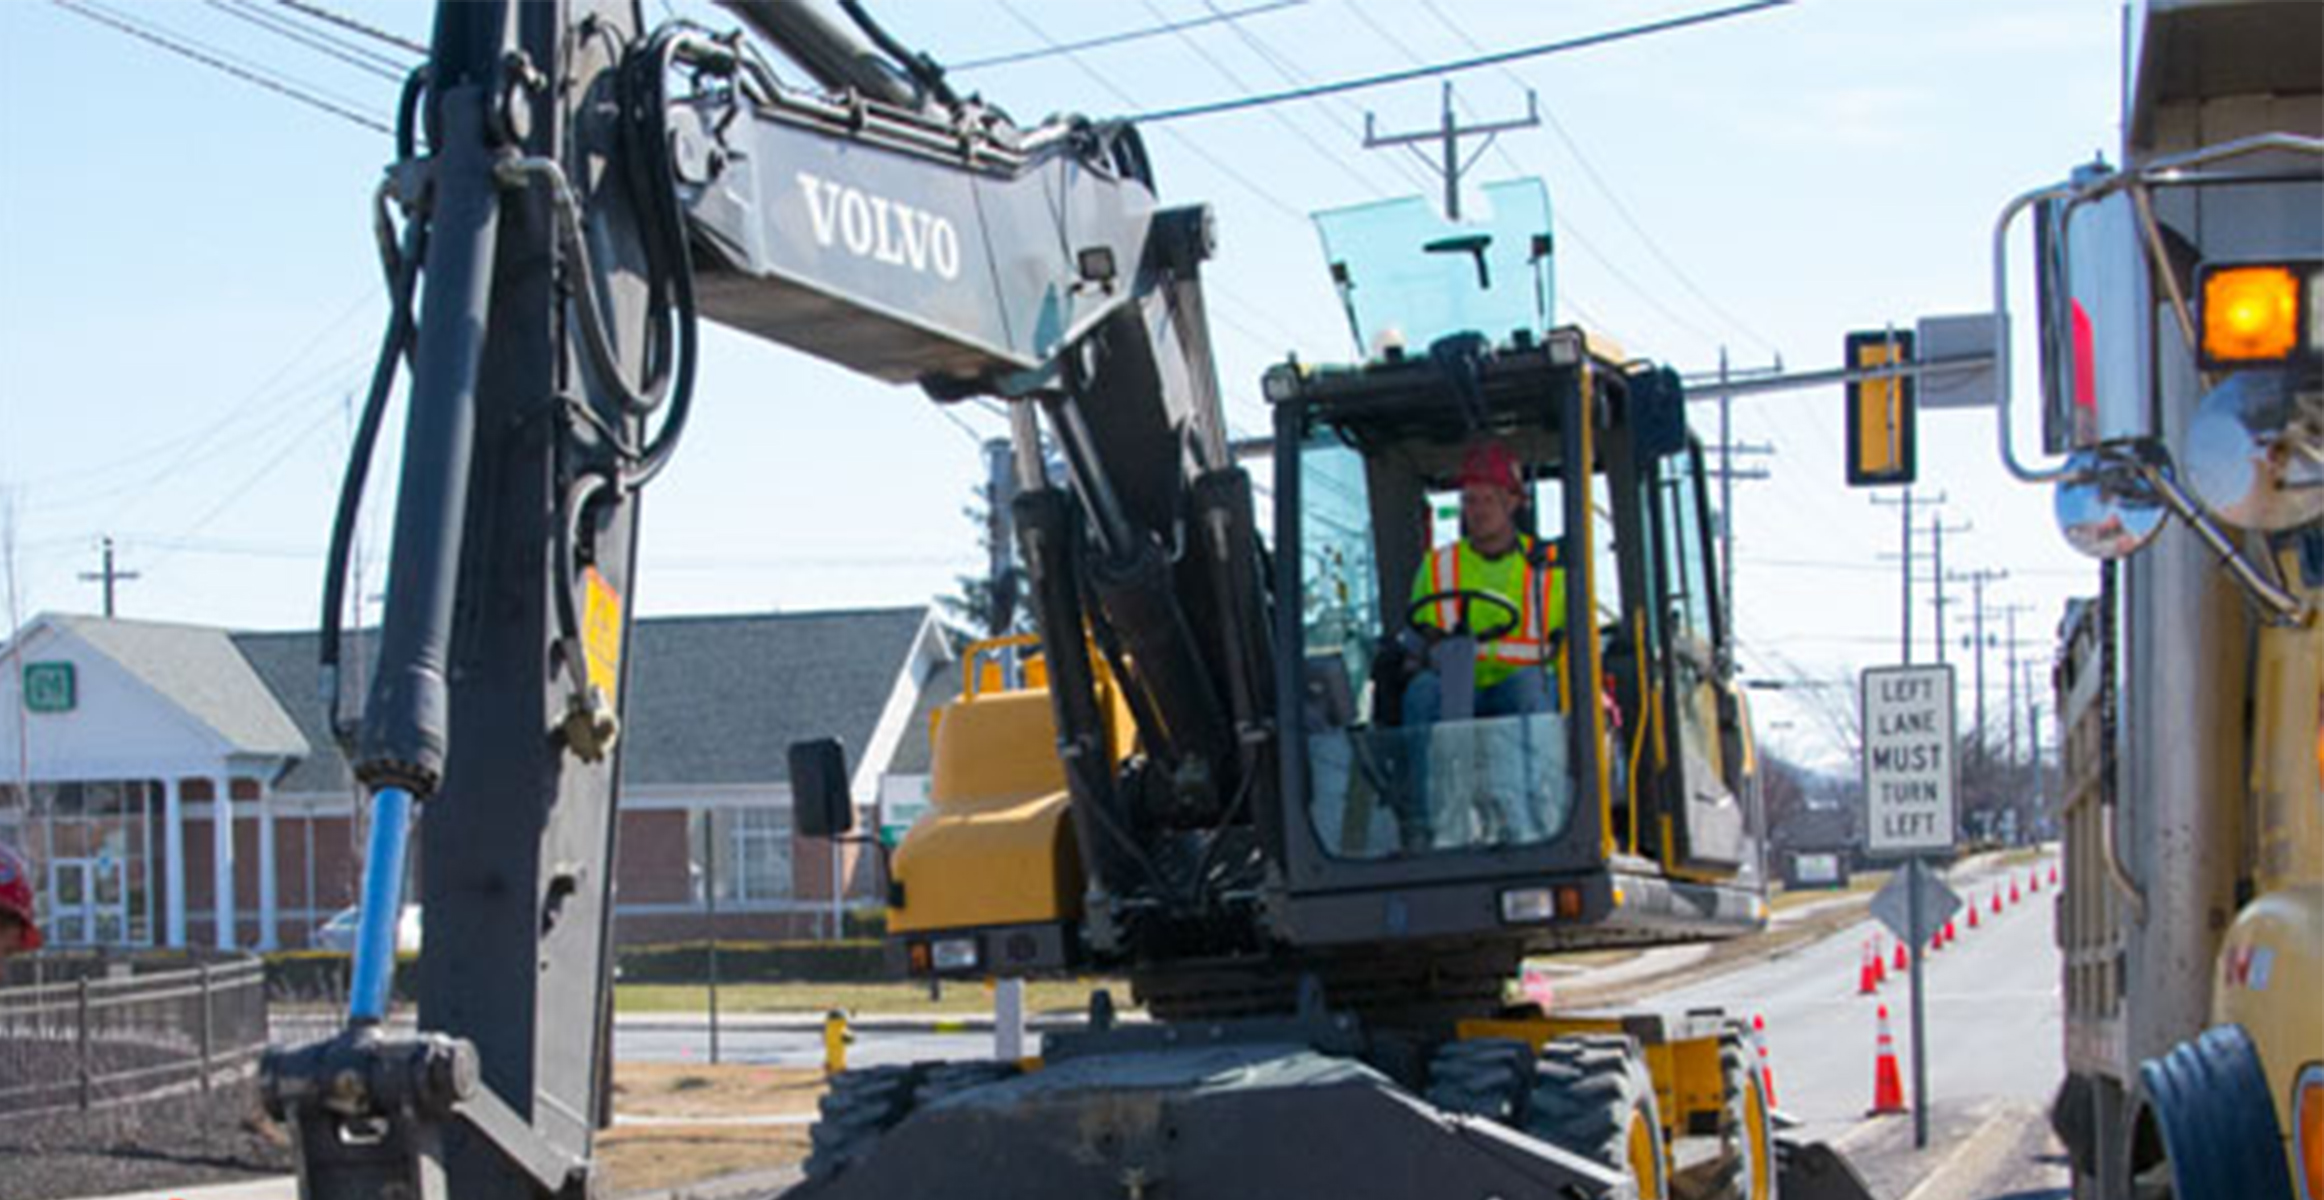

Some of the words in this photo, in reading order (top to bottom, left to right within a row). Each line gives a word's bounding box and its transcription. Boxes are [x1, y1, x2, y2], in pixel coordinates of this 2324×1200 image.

[796, 171, 959, 280] VOLVO
[1881, 679, 1933, 702] LEFT
[1878, 710, 1936, 735] LANE
[1873, 744, 1941, 772] MUST
[1881, 781, 1938, 804] TURN
[1884, 812, 1936, 838] LEFT
